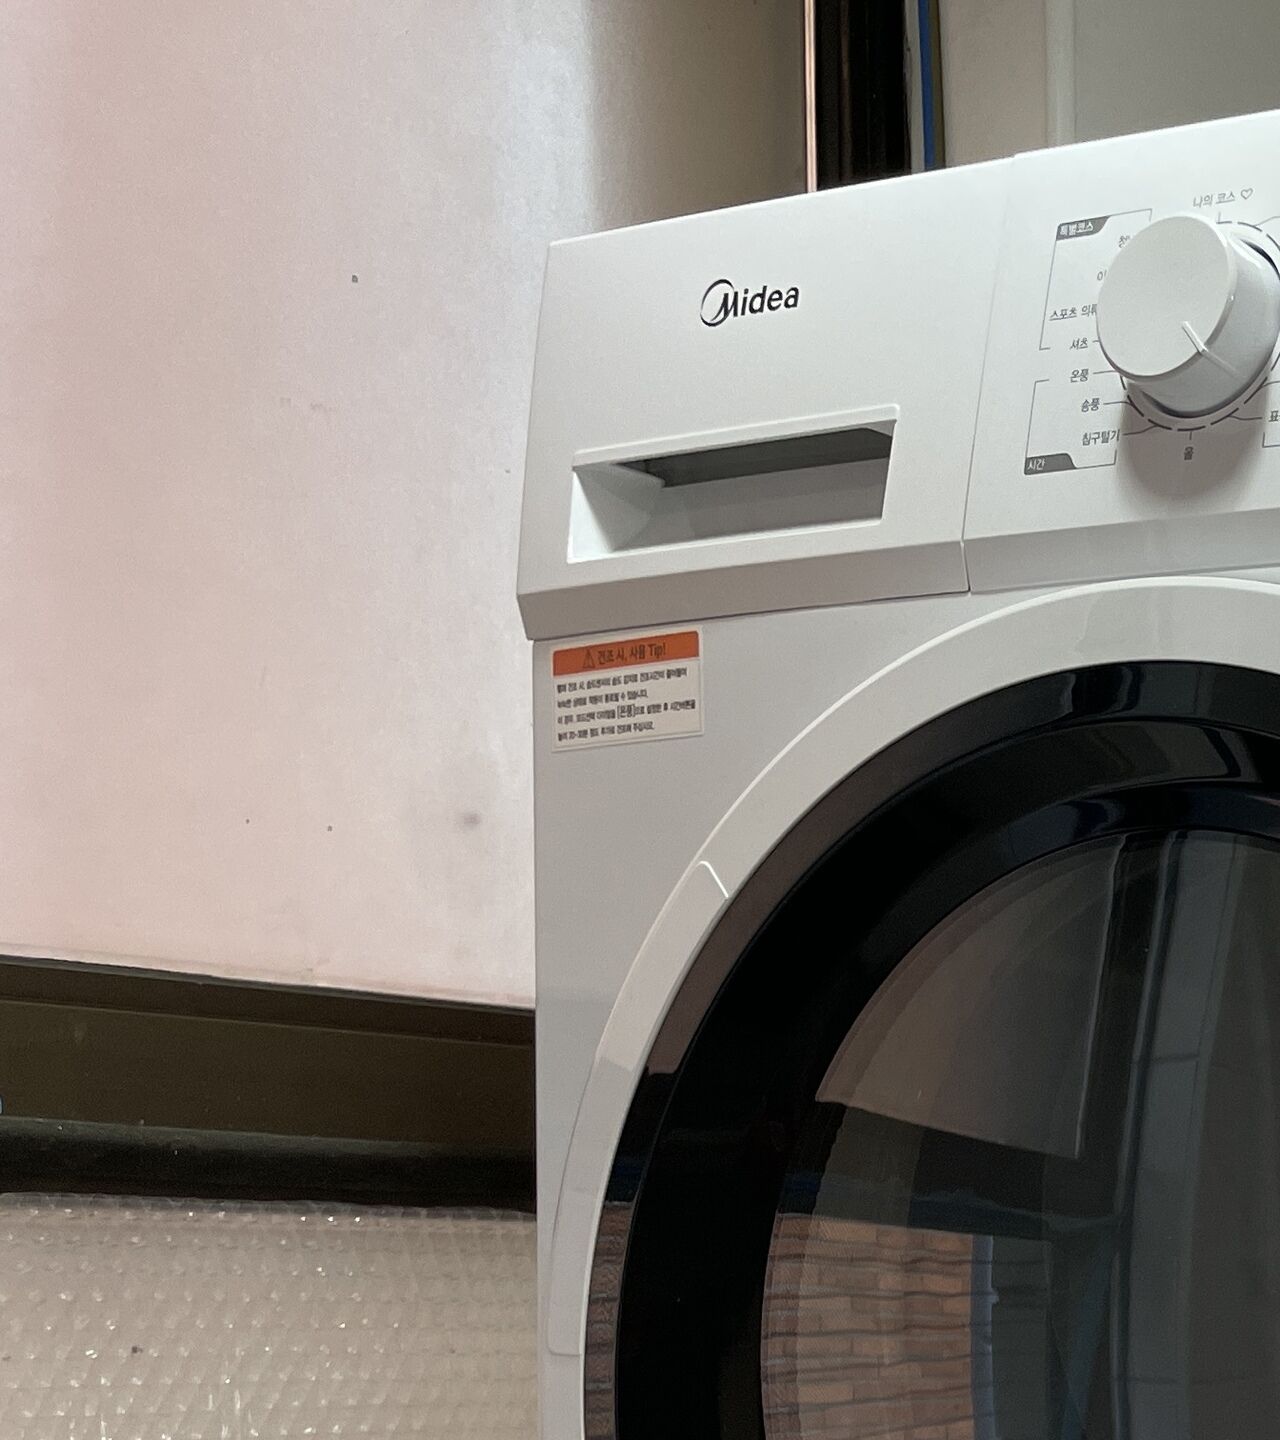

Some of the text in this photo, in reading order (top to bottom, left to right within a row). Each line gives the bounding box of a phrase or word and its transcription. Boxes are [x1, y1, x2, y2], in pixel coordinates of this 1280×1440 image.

[1193, 191, 1236, 208] 나의 코스
[700, 278, 801, 328] Midea
[1049, 307, 1078, 321] 스포츠
[1070, 337, 1088, 350] 셔츠
[1070, 368, 1089, 383] 온풍
[1081, 397, 1100, 413] 송풍
[1082, 428, 1120, 446] 침구털기
[1027, 457, 1046, 471] 시간
